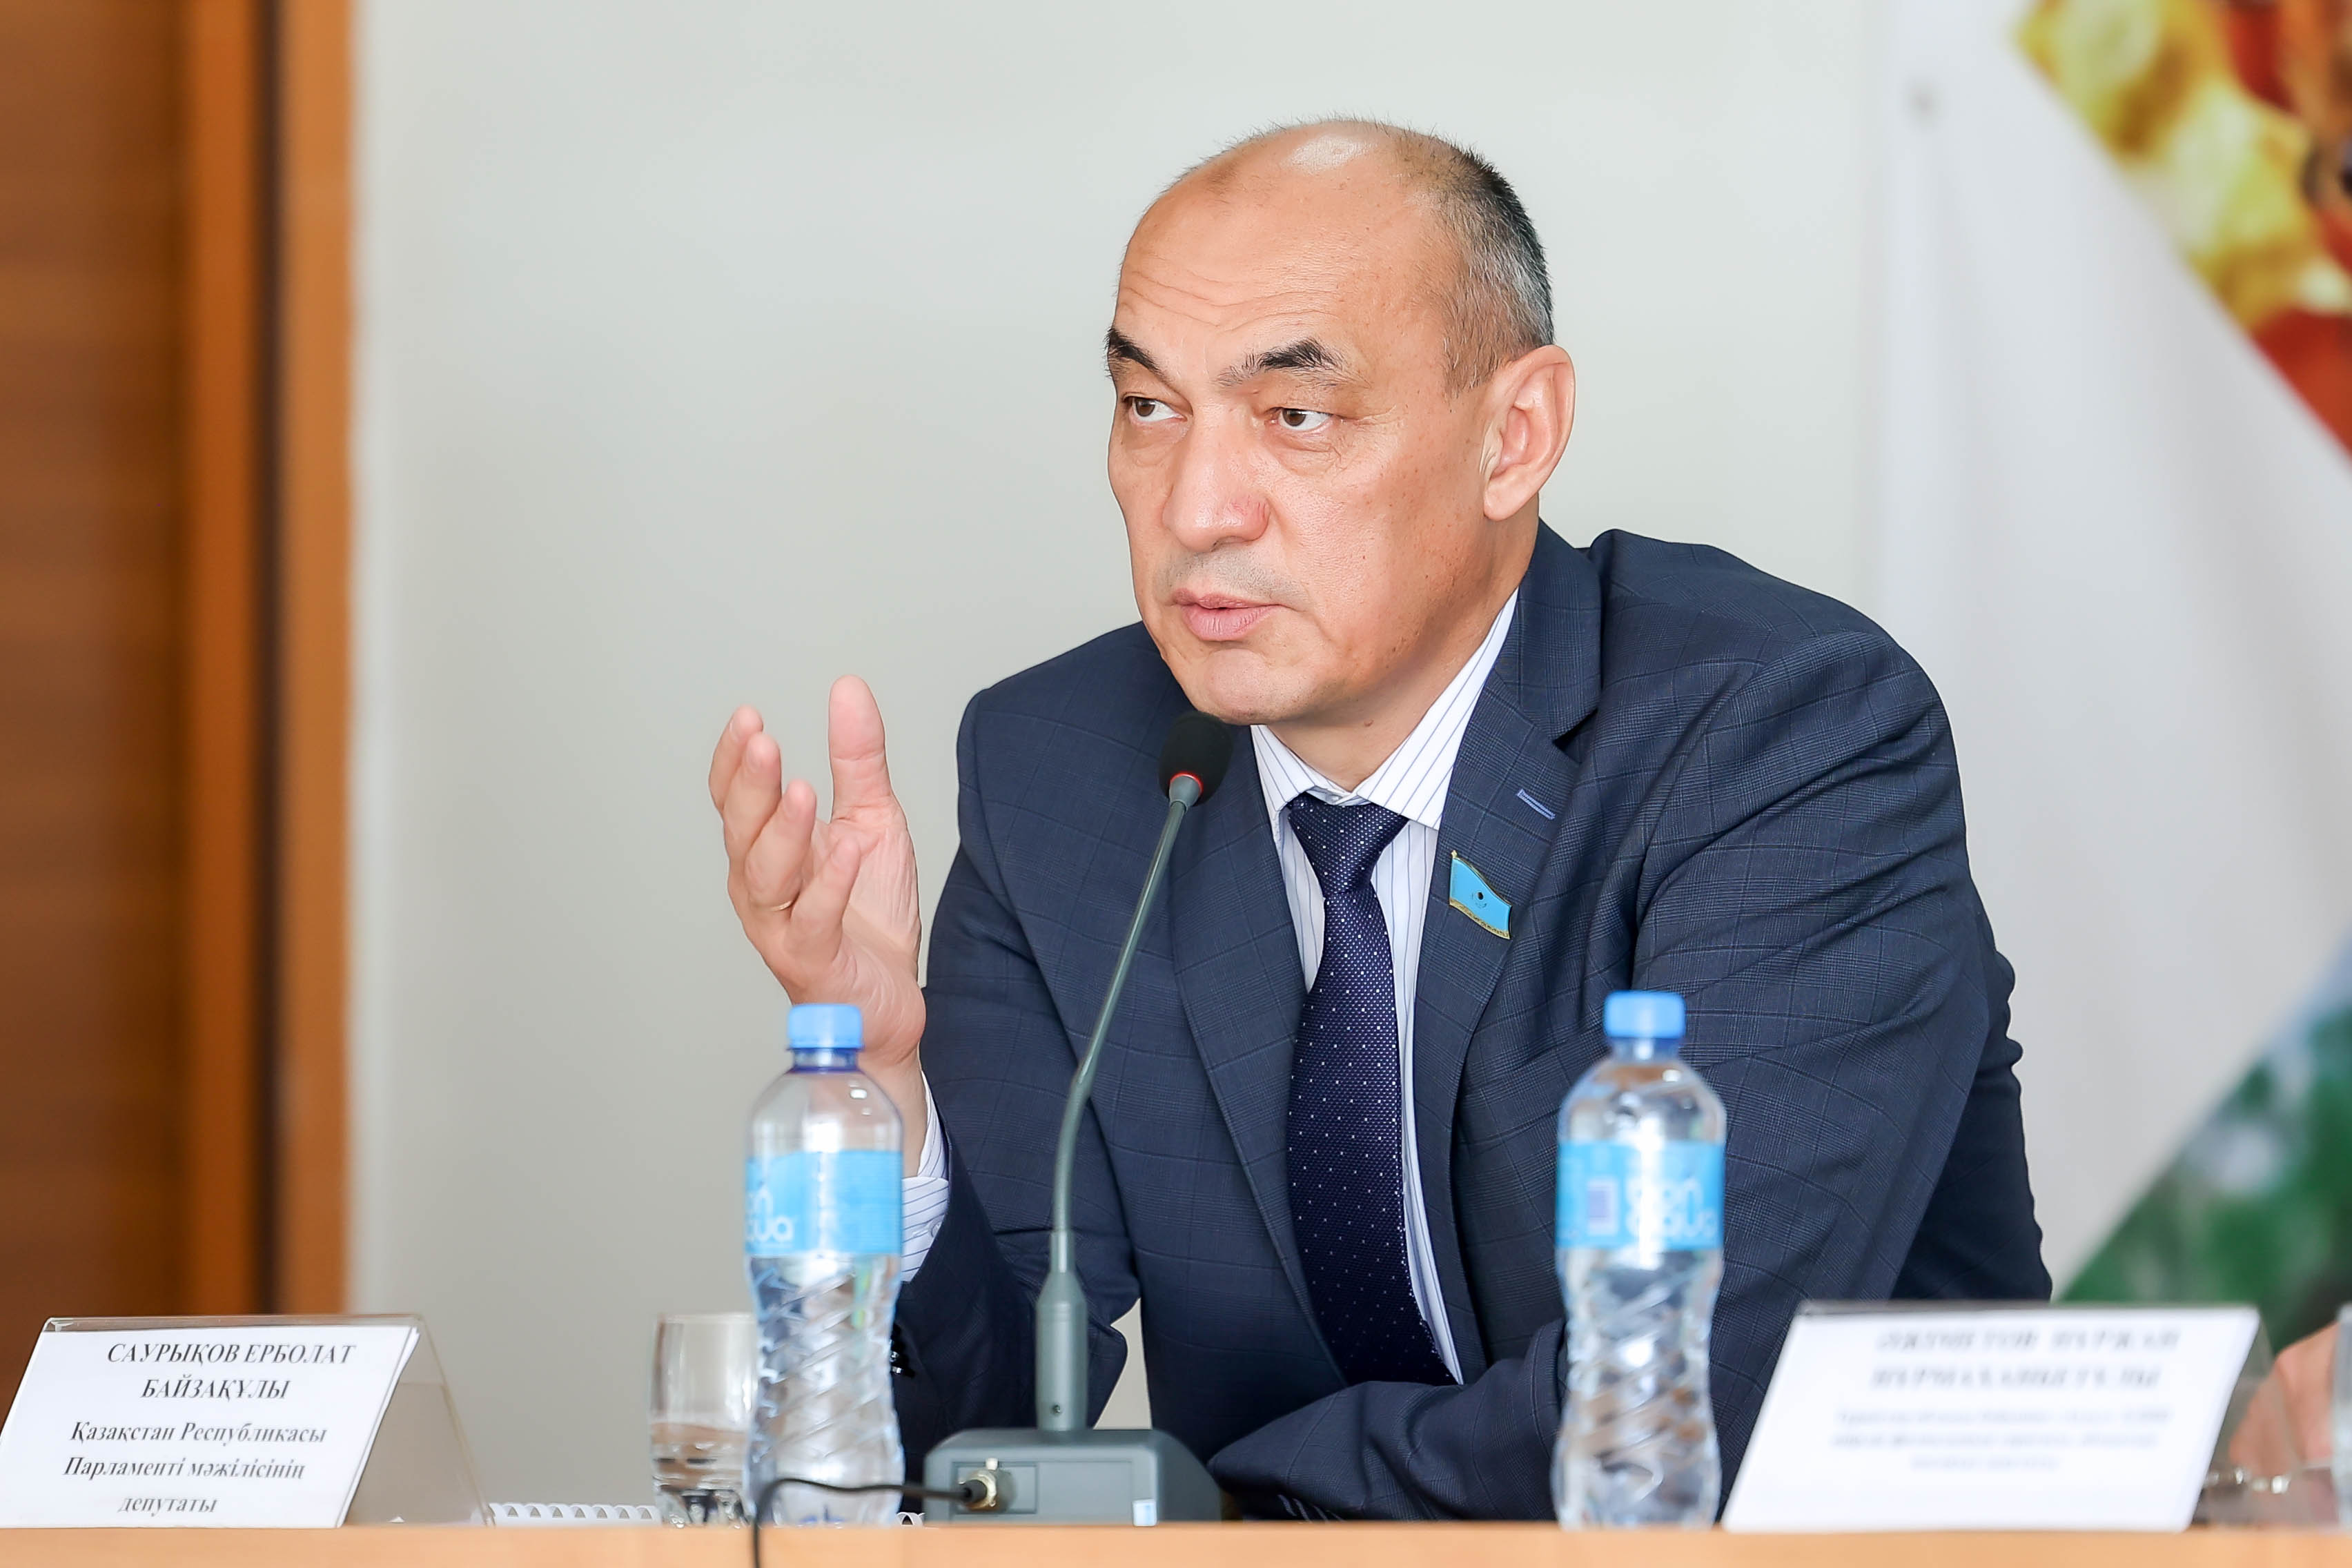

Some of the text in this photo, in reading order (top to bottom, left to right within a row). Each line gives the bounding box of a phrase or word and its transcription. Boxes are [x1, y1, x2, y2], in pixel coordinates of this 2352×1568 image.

[107, 1343, 357, 1366] САУРЫҚОВ ЕРБОЛАТ
[139, 1374, 291, 1402] БАЙЗАҚҰЛЫ
[69, 1421, 327, 1447] Қазақстан Республикасы
[63, 1457, 306, 1480] Парламенті мәжілісінің
[117, 1496, 218, 1517] депутаты
